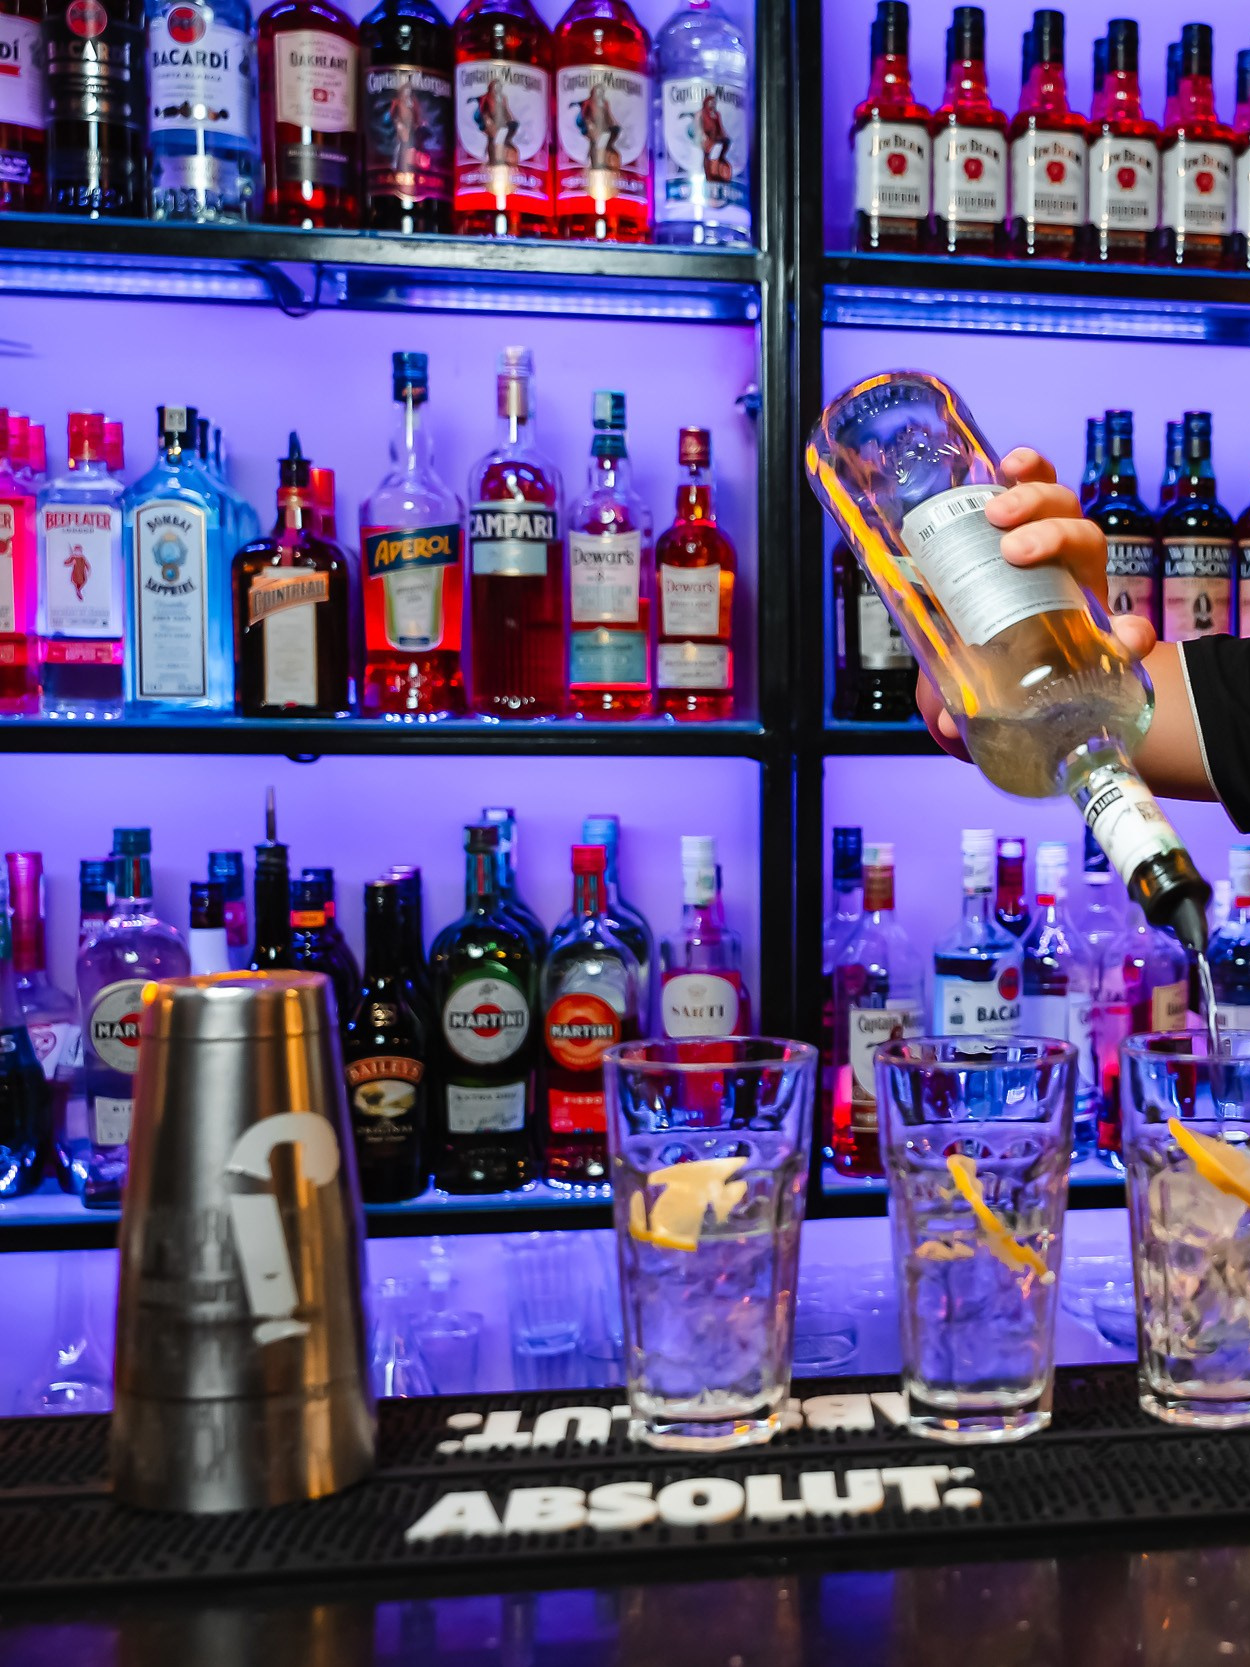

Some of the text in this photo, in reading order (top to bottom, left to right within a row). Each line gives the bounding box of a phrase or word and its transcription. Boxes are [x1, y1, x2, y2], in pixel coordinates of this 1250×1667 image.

[153, 49, 230, 71] BACARDÍ
[45, 511, 112, 531] BEEFEATER
[146, 515, 192, 535] BOMBAY
[470, 512, 555, 541] CAMPARI
[374, 535, 452, 568] APEROL
[145, 576, 196, 598] SAPPHIRE
[252, 580, 326, 616] COINTREAU
[452, 1011, 523, 1028] MARTINI
[551, 1024, 614, 1038] MARTINI
[349, 1057, 422, 1081] BAILEYS
